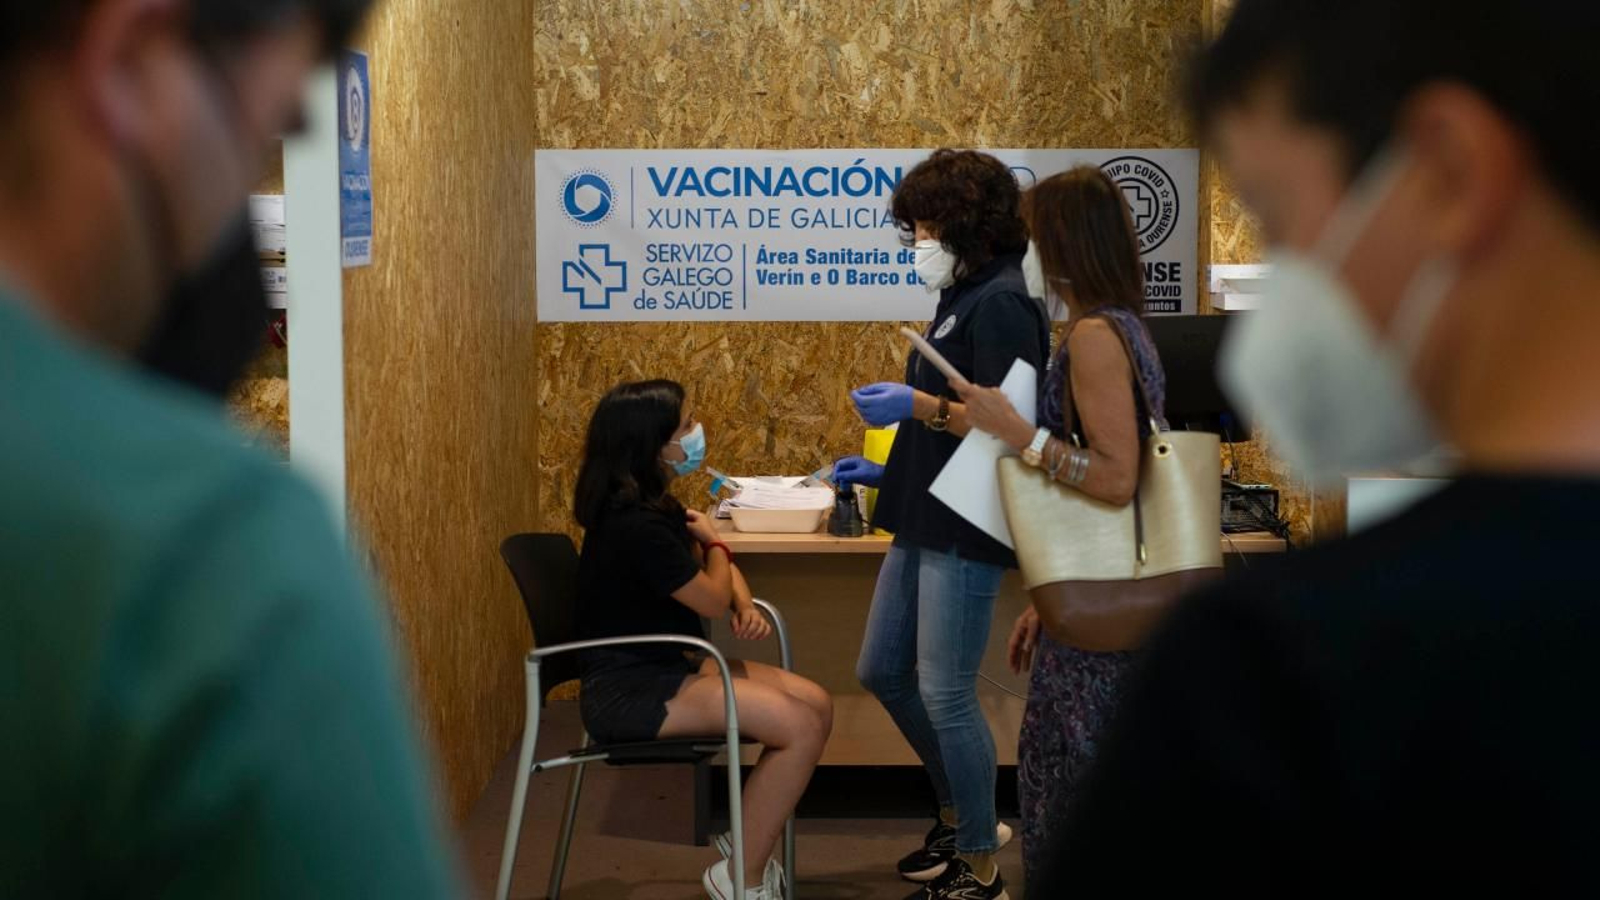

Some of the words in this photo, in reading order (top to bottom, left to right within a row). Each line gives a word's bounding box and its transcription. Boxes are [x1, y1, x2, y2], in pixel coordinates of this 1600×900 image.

[647, 158, 902, 197] VACINACIÓN
[1134, 164, 1165, 188] COVID
[647, 208, 738, 229] XUNTA
[748, 208, 781, 229] DE
[790, 207, 897, 229] GALICIA
[1146, 200, 1172, 244] OURENSE
[645, 243, 733, 263] SERVIZO
[756, 244, 799, 265] Área
[805, 248, 890, 265] Sanitaria
[642, 267, 733, 287] GALEGO
[756, 268, 804, 286] Verín
[810, 272, 822, 286] e
[827, 268, 840, 286] O
[845, 268, 900, 286] Barco
[633, 288, 657, 310] de
[663, 287, 733, 310] SAÚDE
[1144, 285, 1181, 297] COVID
